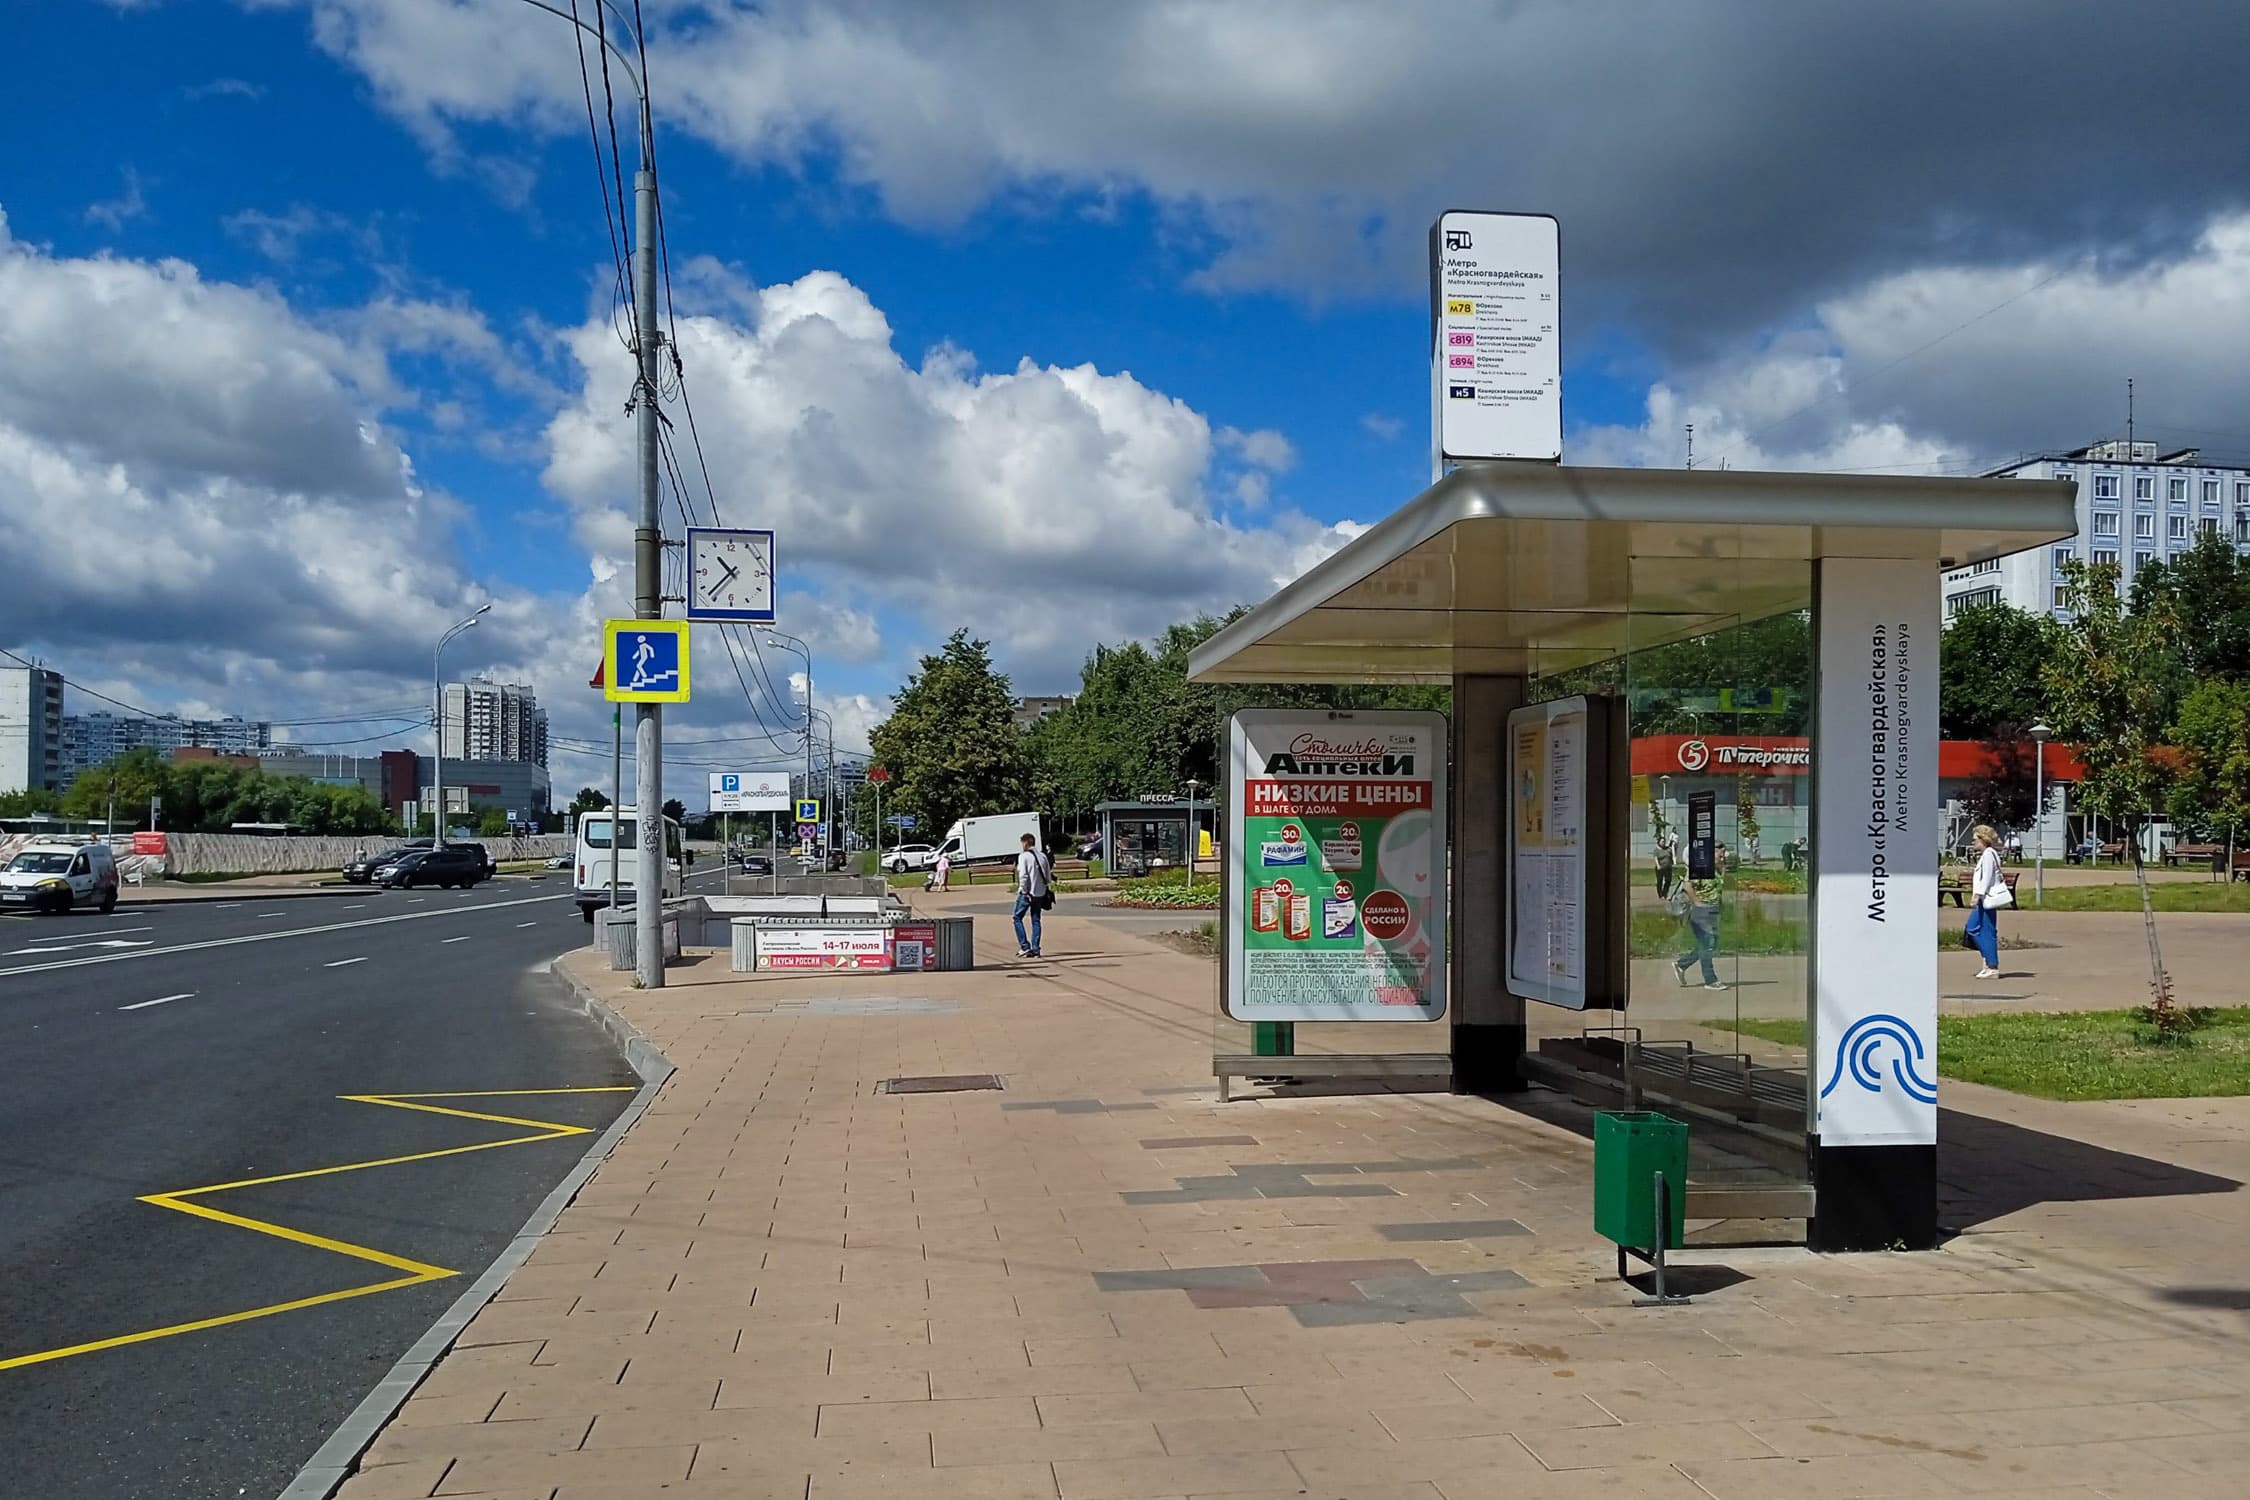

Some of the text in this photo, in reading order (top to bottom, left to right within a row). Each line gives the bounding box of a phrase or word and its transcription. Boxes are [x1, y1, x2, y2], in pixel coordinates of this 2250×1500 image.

[1447, 259, 1478, 269] Метро
[1447, 267, 1544, 279] «Красногвардейская»
[726, 544, 736, 552] 12
[702, 568, 708, 576] 9
[728, 593, 734, 601] 6
[1895, 622, 1912, 832] Metro Krasnogvardeyskaya
[1289, 732, 1389, 756] Столички
[1263, 753, 1414, 776] АптекИ
[1867, 623, 1890, 922] Метро «Красногвардейская»
[1140, 793, 1175, 803] ПРЕССА
[1254, 783, 1422, 806] НИЗКИЕ ЦЕНЫ
[1254, 805, 1338, 815] В ШАГЕ ОТ ДОМА
[1266, 846, 1305, 854] РАФАМИН
[1365, 906, 1406, 914] СДЕЛАНО В
[1365, 916, 1406, 925] РОССИИ
[852, 943, 880, 951] июля
[772, 956, 821, 966] ВКУСЫ РОССИИ
[1250, 974, 1288, 989] ИМЕЮТСЯ
[1250, 989, 1297, 1004] ПОЛУЧЕНИЕ
[1302, 989, 1364, 1004] КОНСУЛЬТАЦИИ
